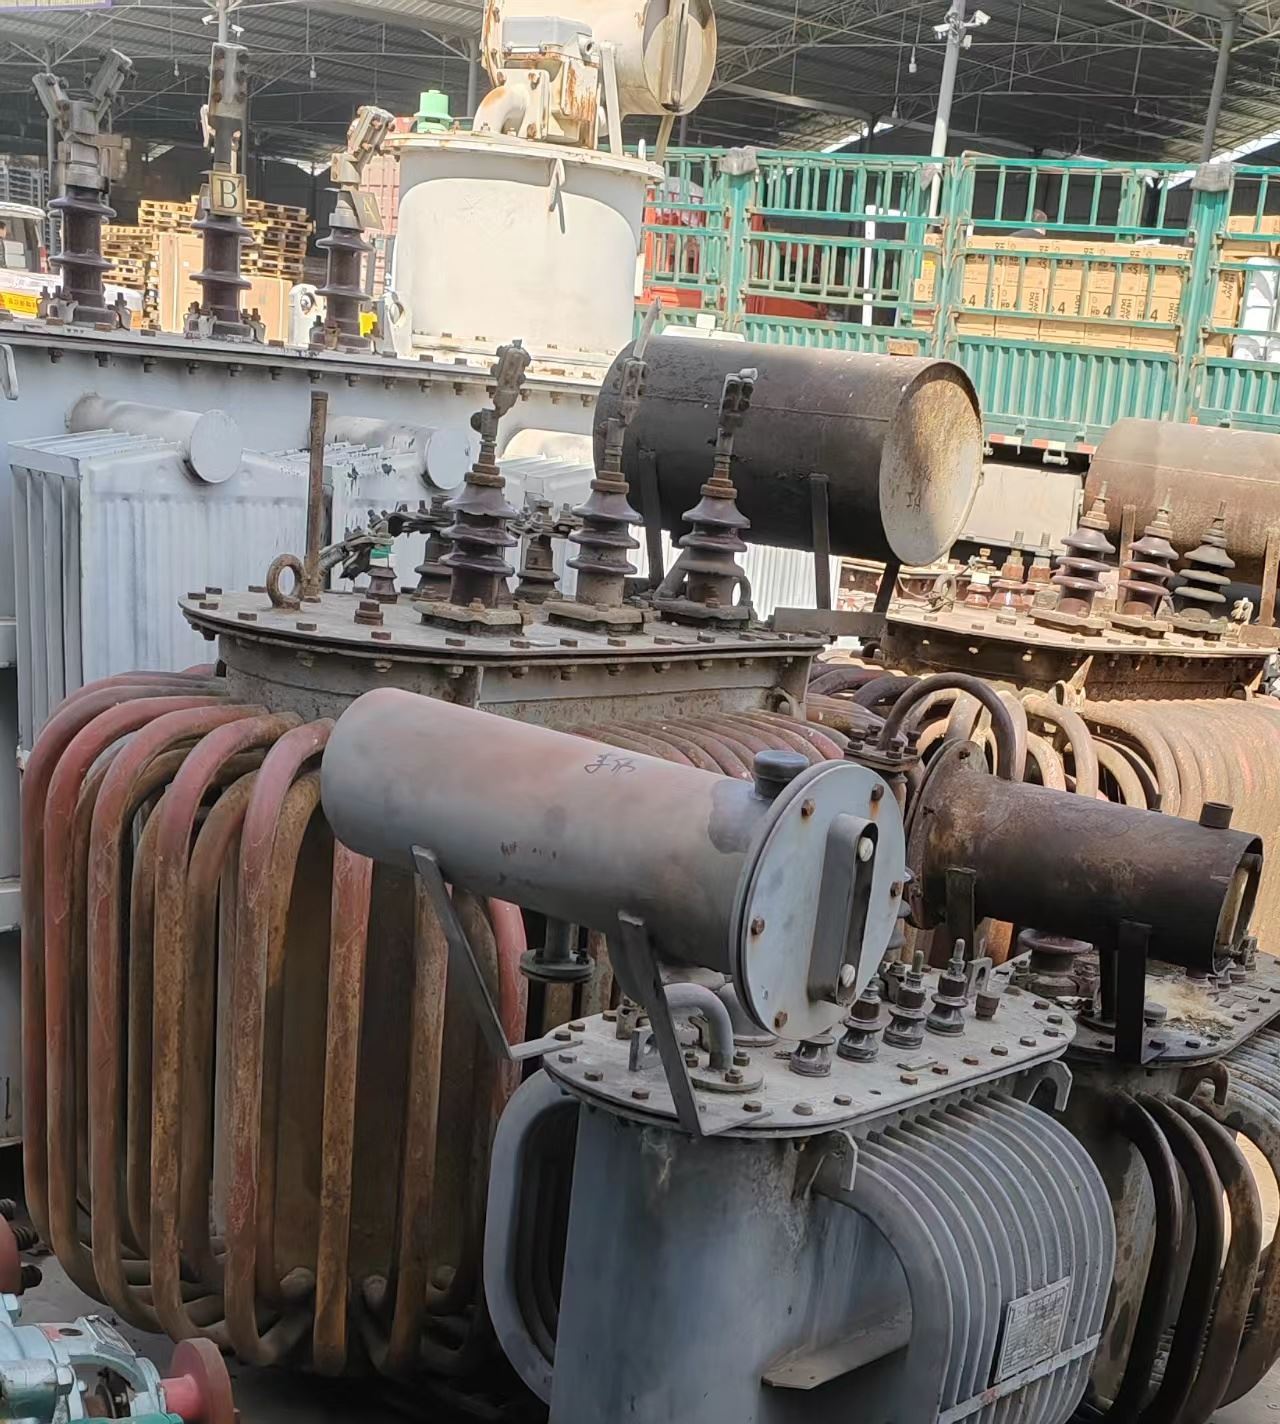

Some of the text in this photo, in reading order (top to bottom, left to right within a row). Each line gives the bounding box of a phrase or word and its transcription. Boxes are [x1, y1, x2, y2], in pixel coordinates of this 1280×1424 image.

[968, 294, 976, 306] 4
[1057, 302, 1065, 314] 4
[1150, 309, 1158, 321] 4
